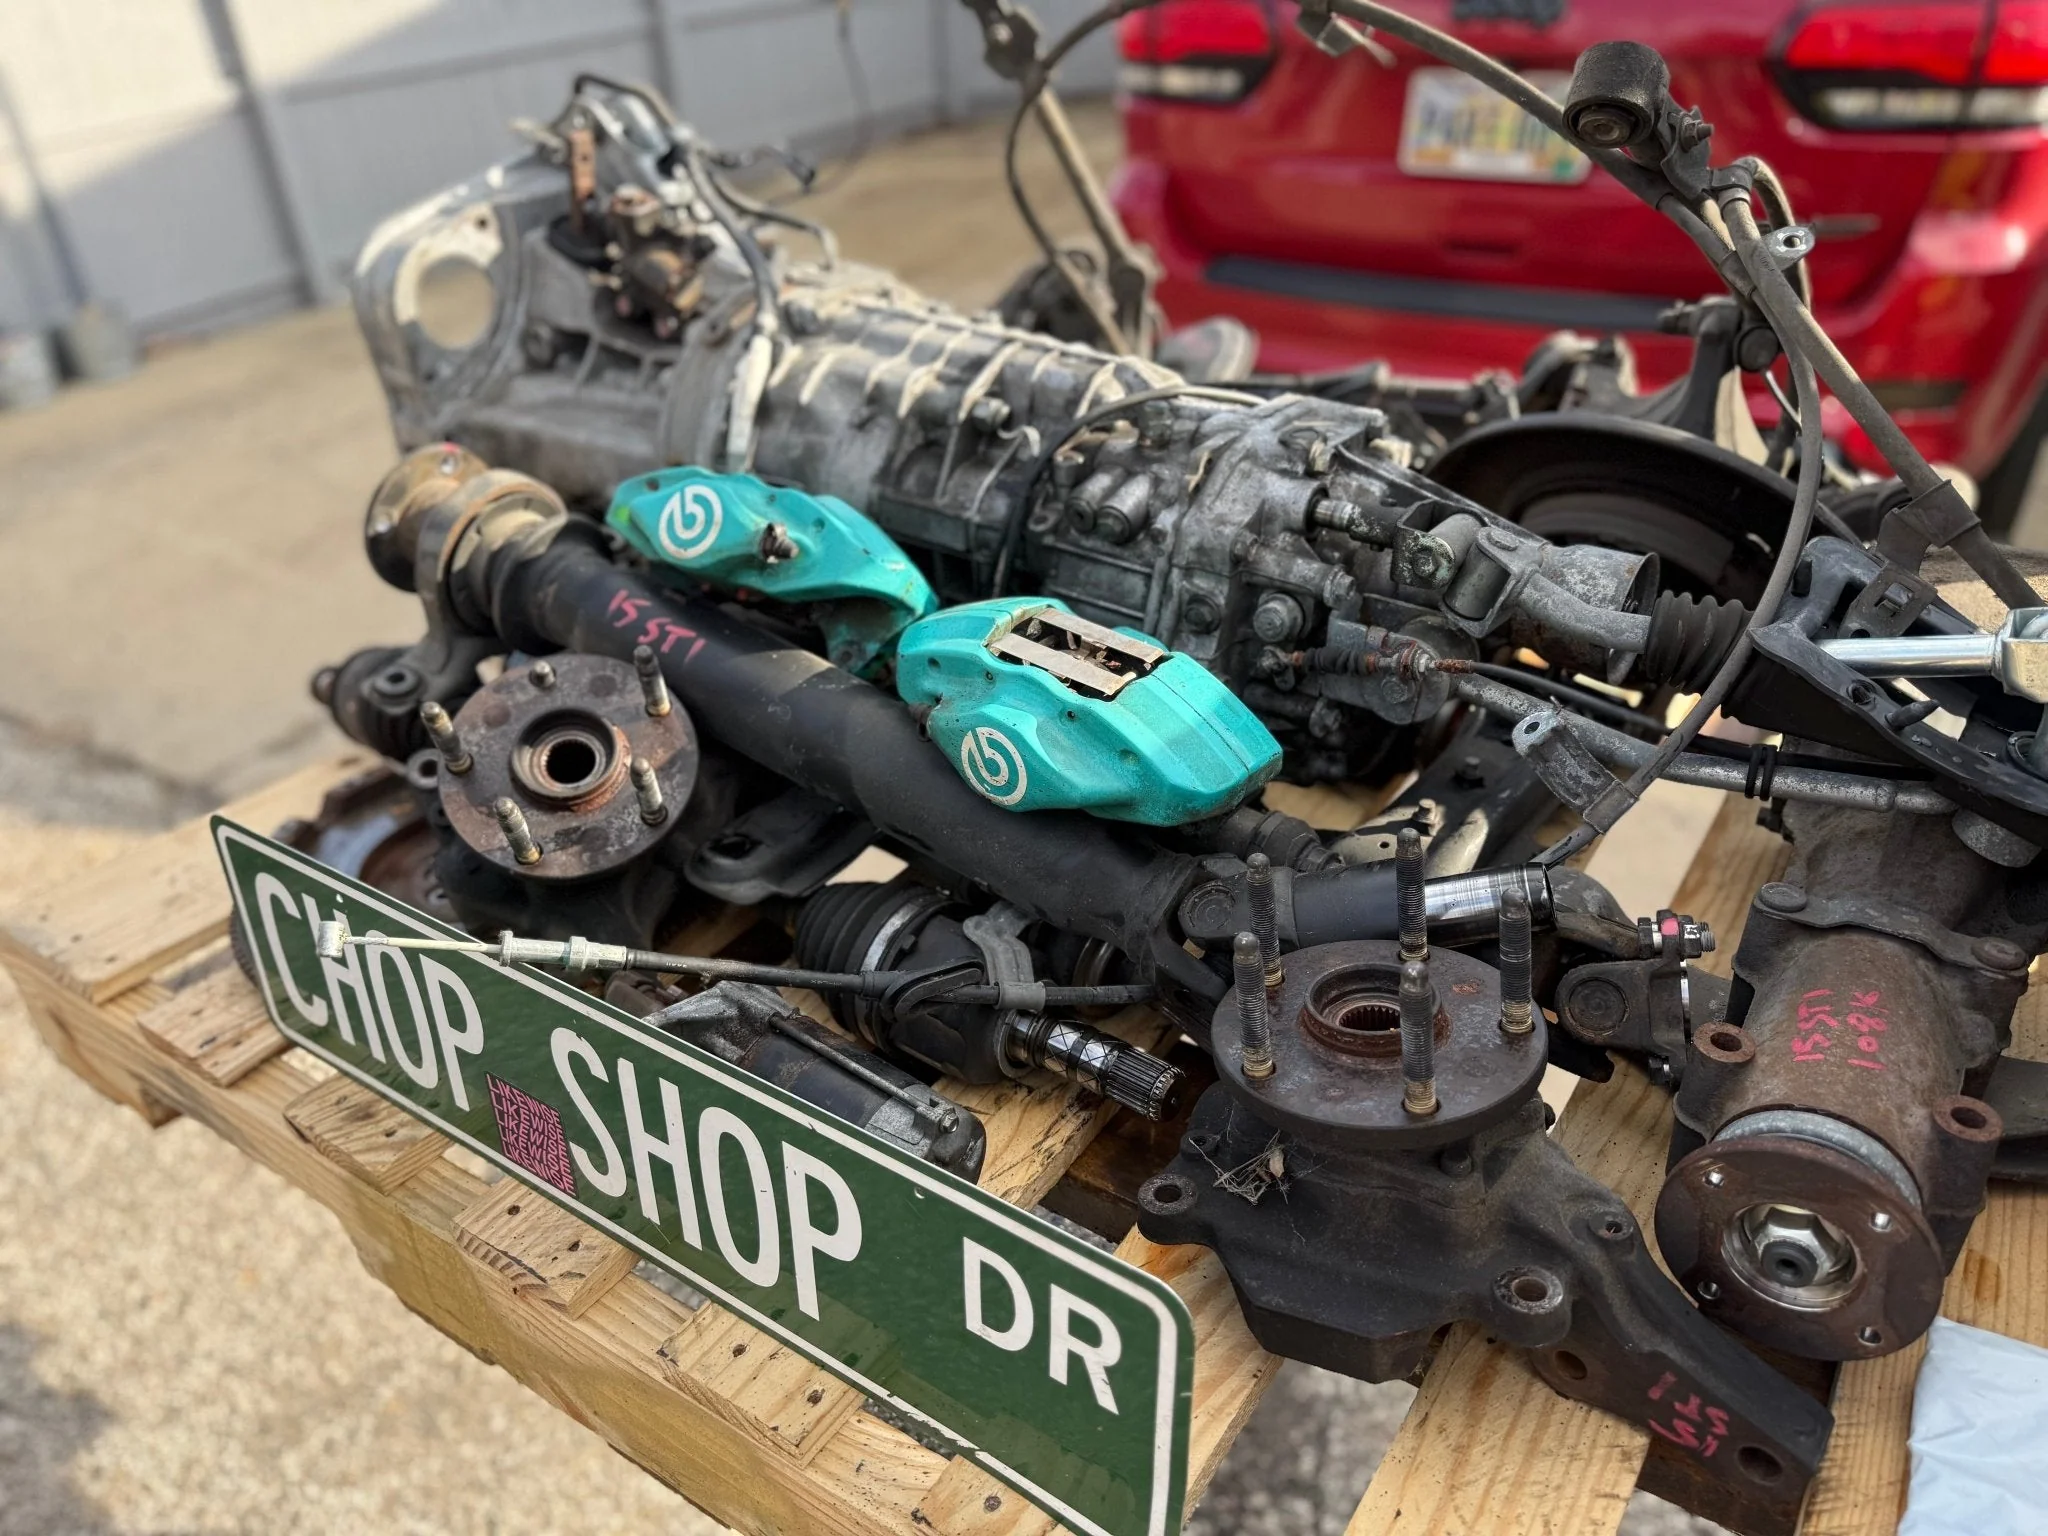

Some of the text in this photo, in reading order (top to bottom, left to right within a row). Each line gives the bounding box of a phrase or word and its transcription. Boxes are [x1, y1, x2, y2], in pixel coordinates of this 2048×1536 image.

[486, 1073, 562, 1128] LIKEWISE
[491, 1091, 566, 1147] LIKEWISE
[255, 872, 1122, 1415] CHOP SHOP DR
[495, 1107, 570, 1163] LIKEWISE
[499, 1124, 573, 1179] LIKEWISE
[503, 1141, 577, 1197] LIKEWISE
